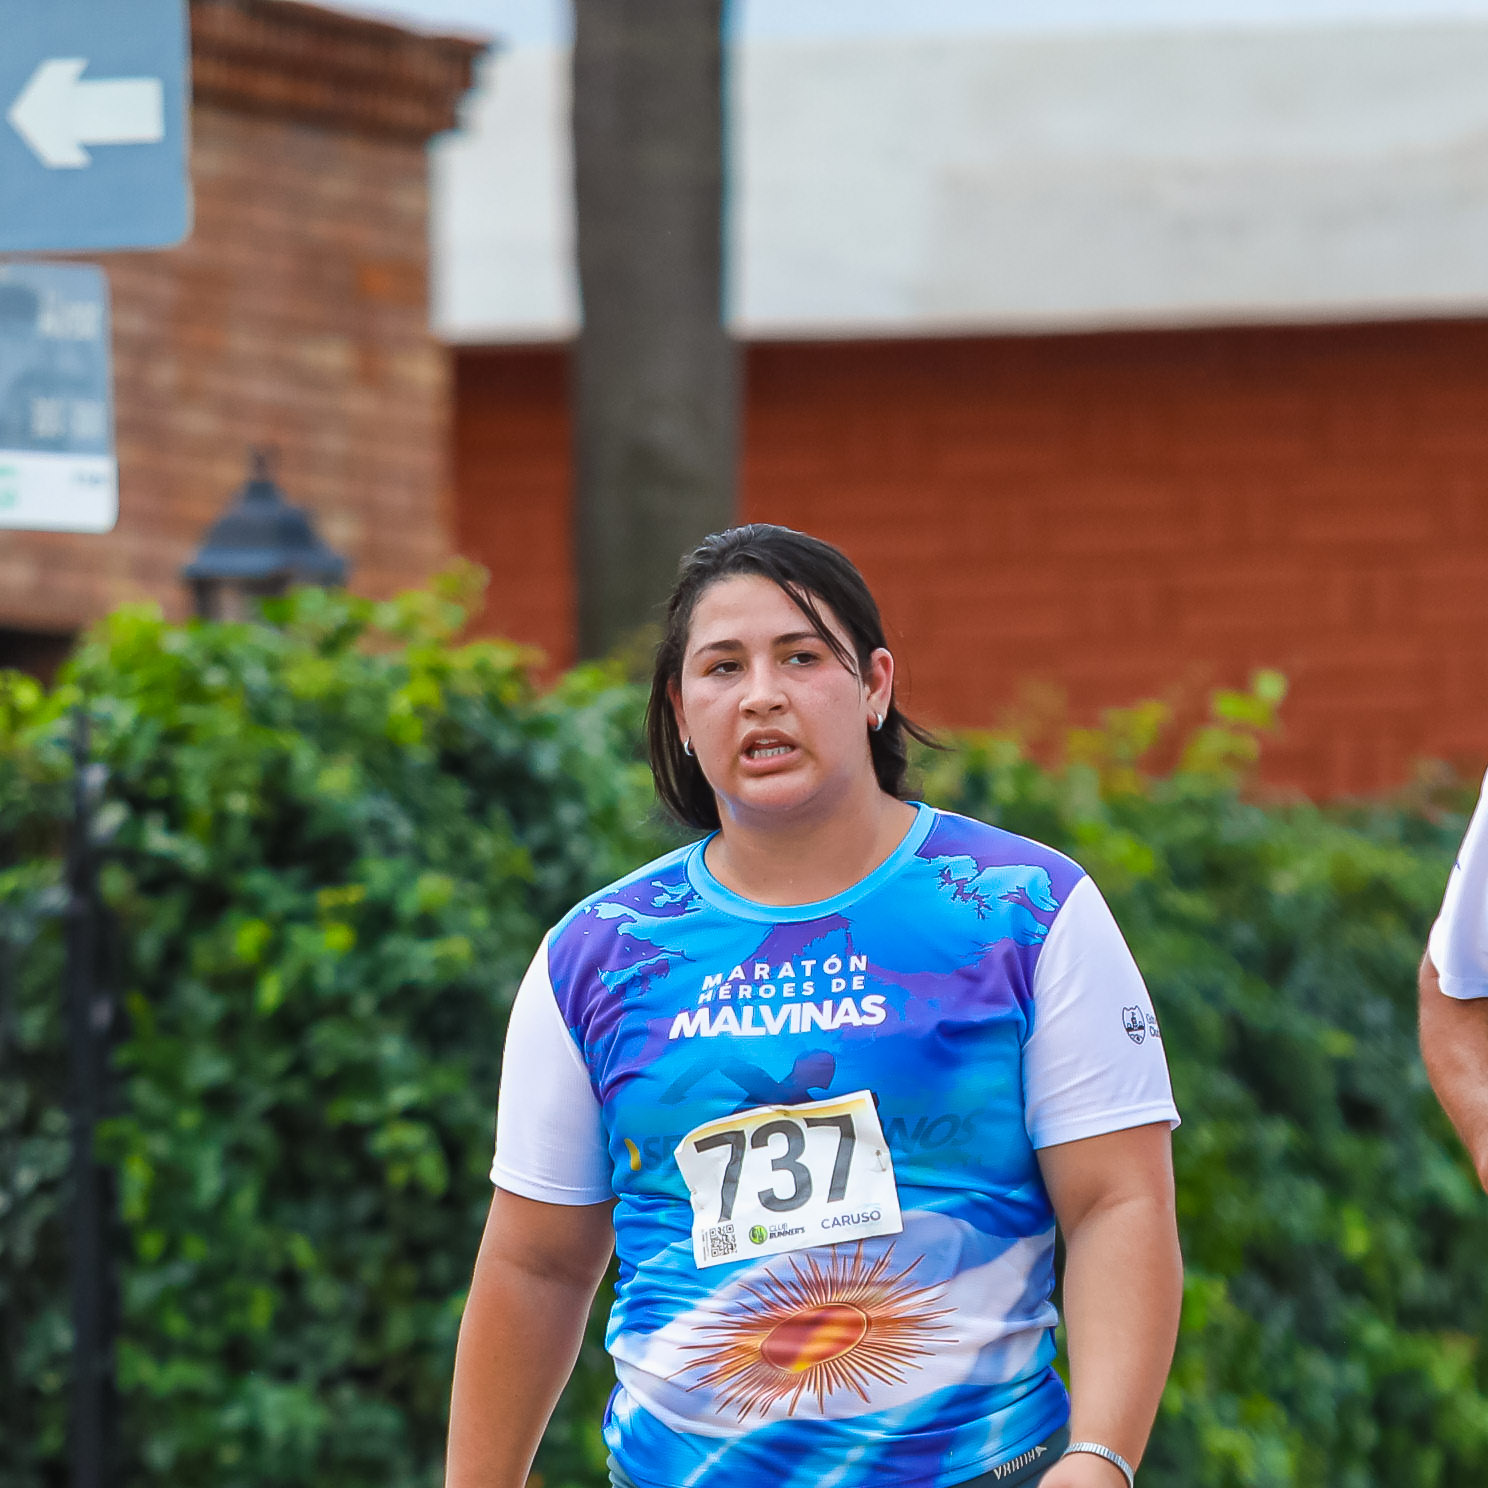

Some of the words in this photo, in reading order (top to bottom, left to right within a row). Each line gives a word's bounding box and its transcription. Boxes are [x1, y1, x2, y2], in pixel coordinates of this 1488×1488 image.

[698, 981, 815, 1004] HÉROES
[831, 976, 865, 993] DE
[701, 954, 868, 991] MARATÓN
[669, 994, 887, 1040] MALVINAS
[693, 1114, 856, 1222] 737
[821, 1210, 881, 1230] CARUSO
